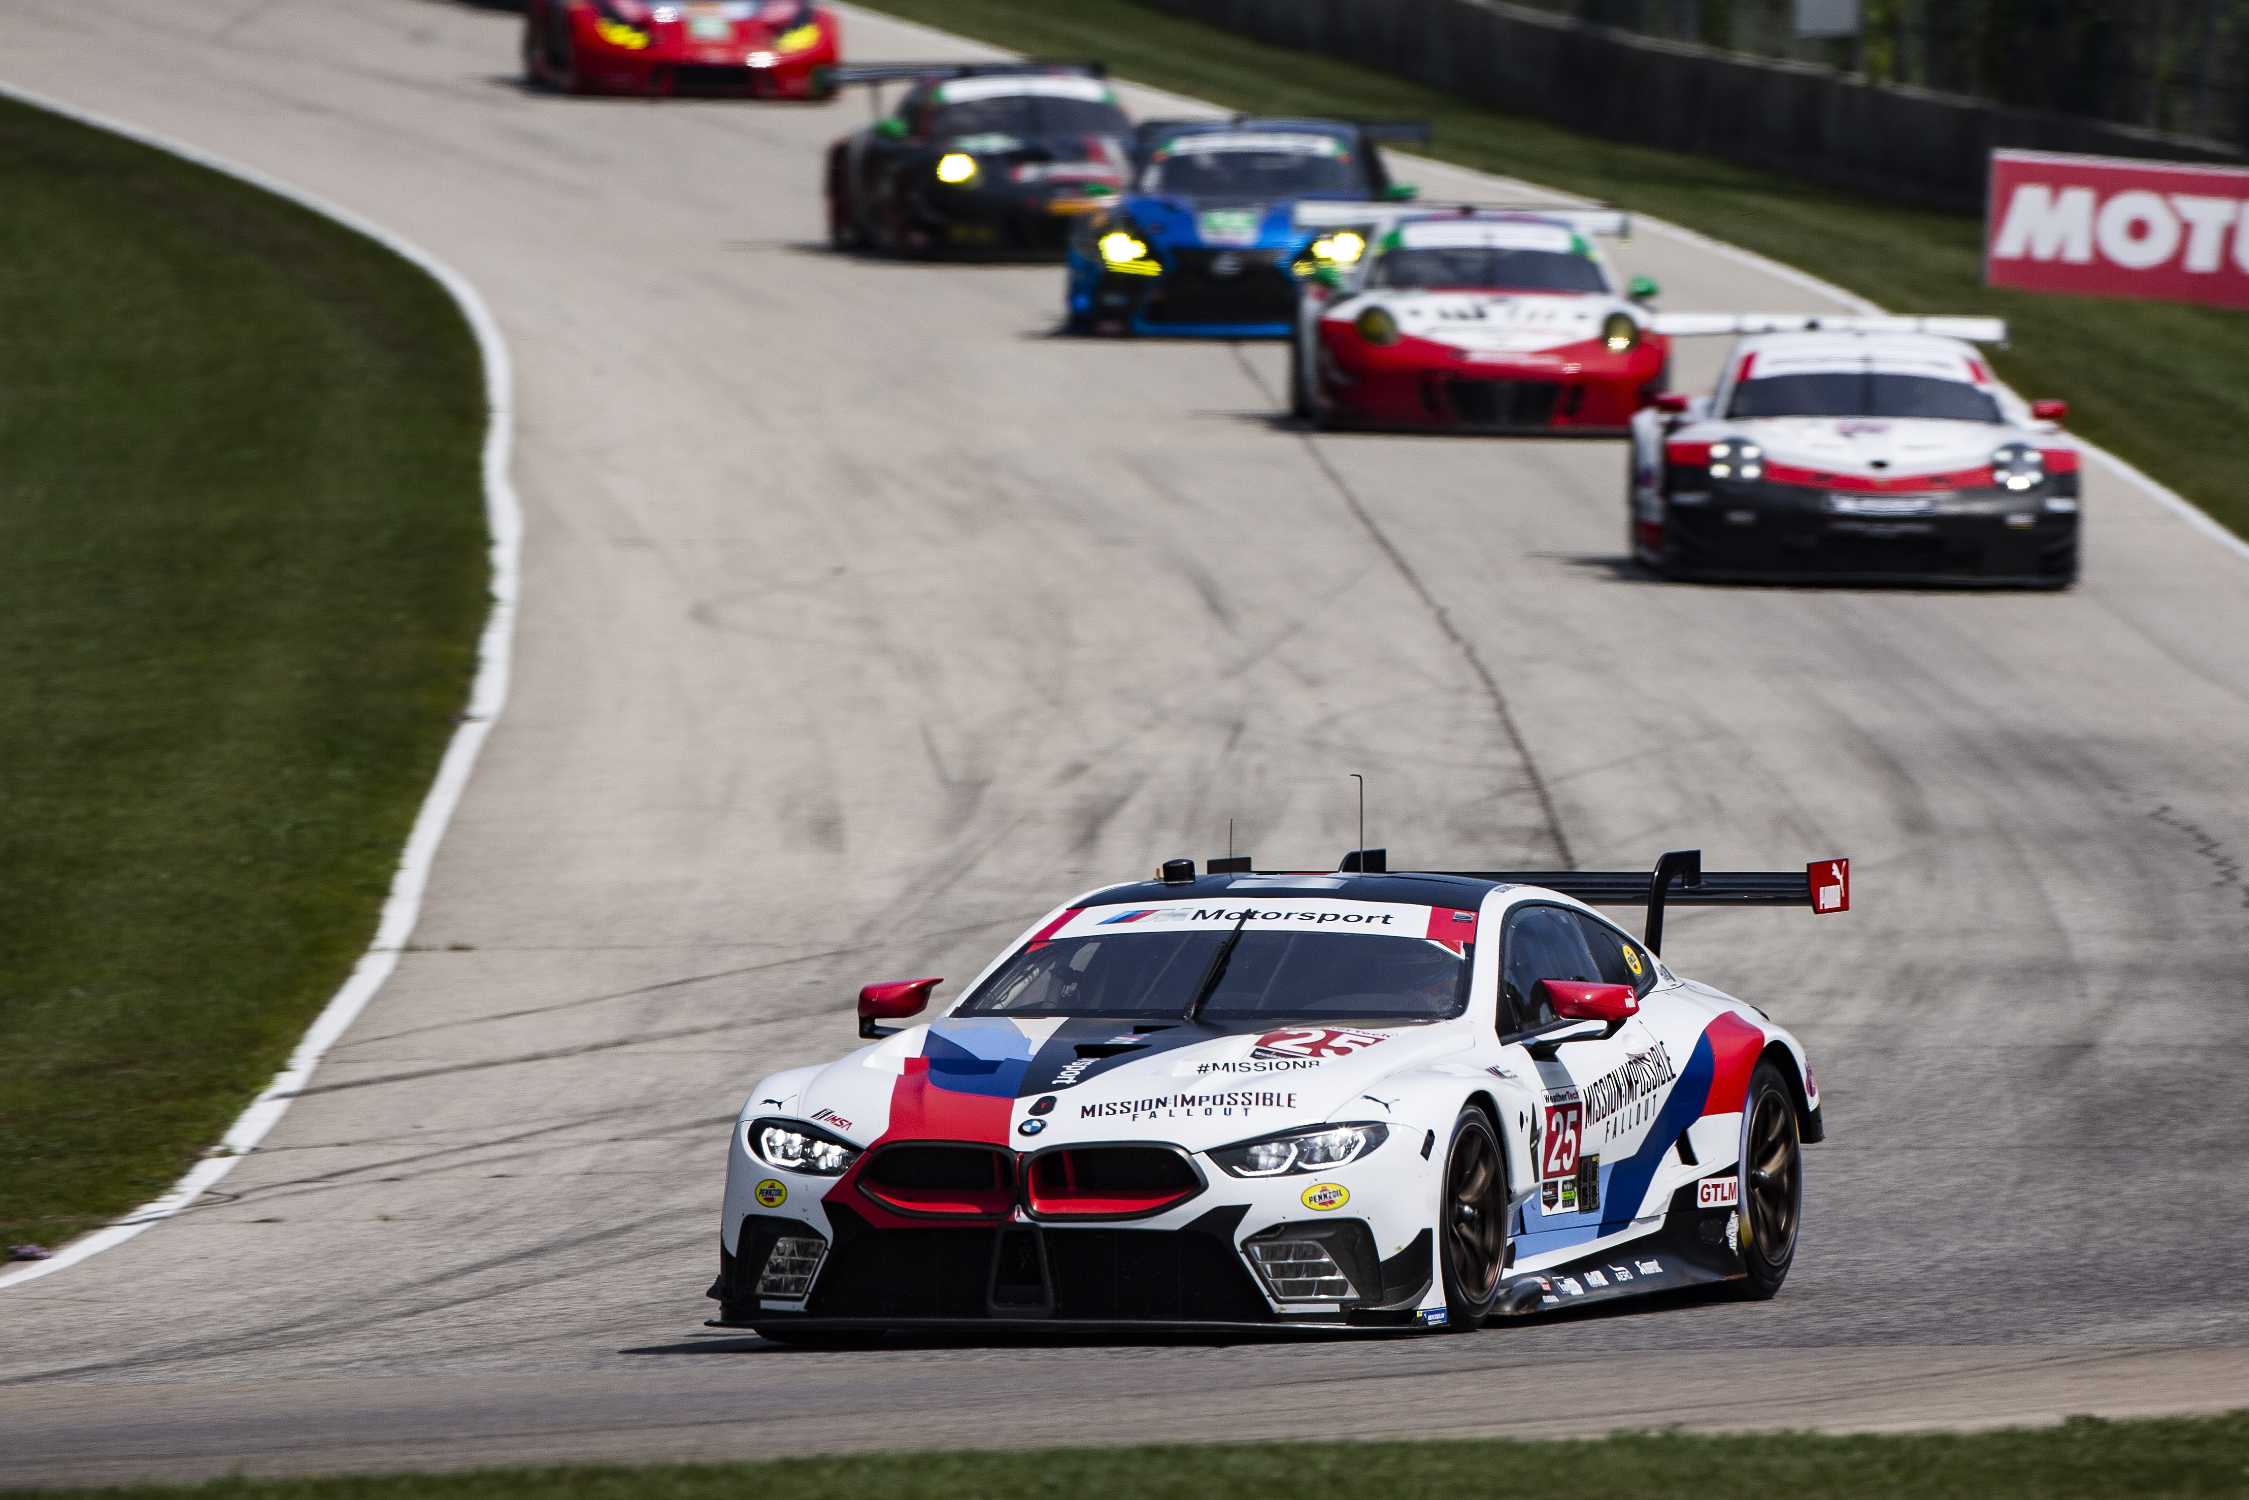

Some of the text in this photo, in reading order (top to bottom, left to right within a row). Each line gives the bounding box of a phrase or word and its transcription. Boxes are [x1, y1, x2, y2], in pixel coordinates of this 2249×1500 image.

[1993, 183, 2249, 275] MOT
[1191, 908, 1395, 926] Motorsport
[1132, 1107, 1251, 1122] FALLOUT
[1605, 1093, 1657, 1144] FALLOUT
[1547, 1109, 1578, 1172] 25
[1700, 1182, 1737, 1203] GTLM
